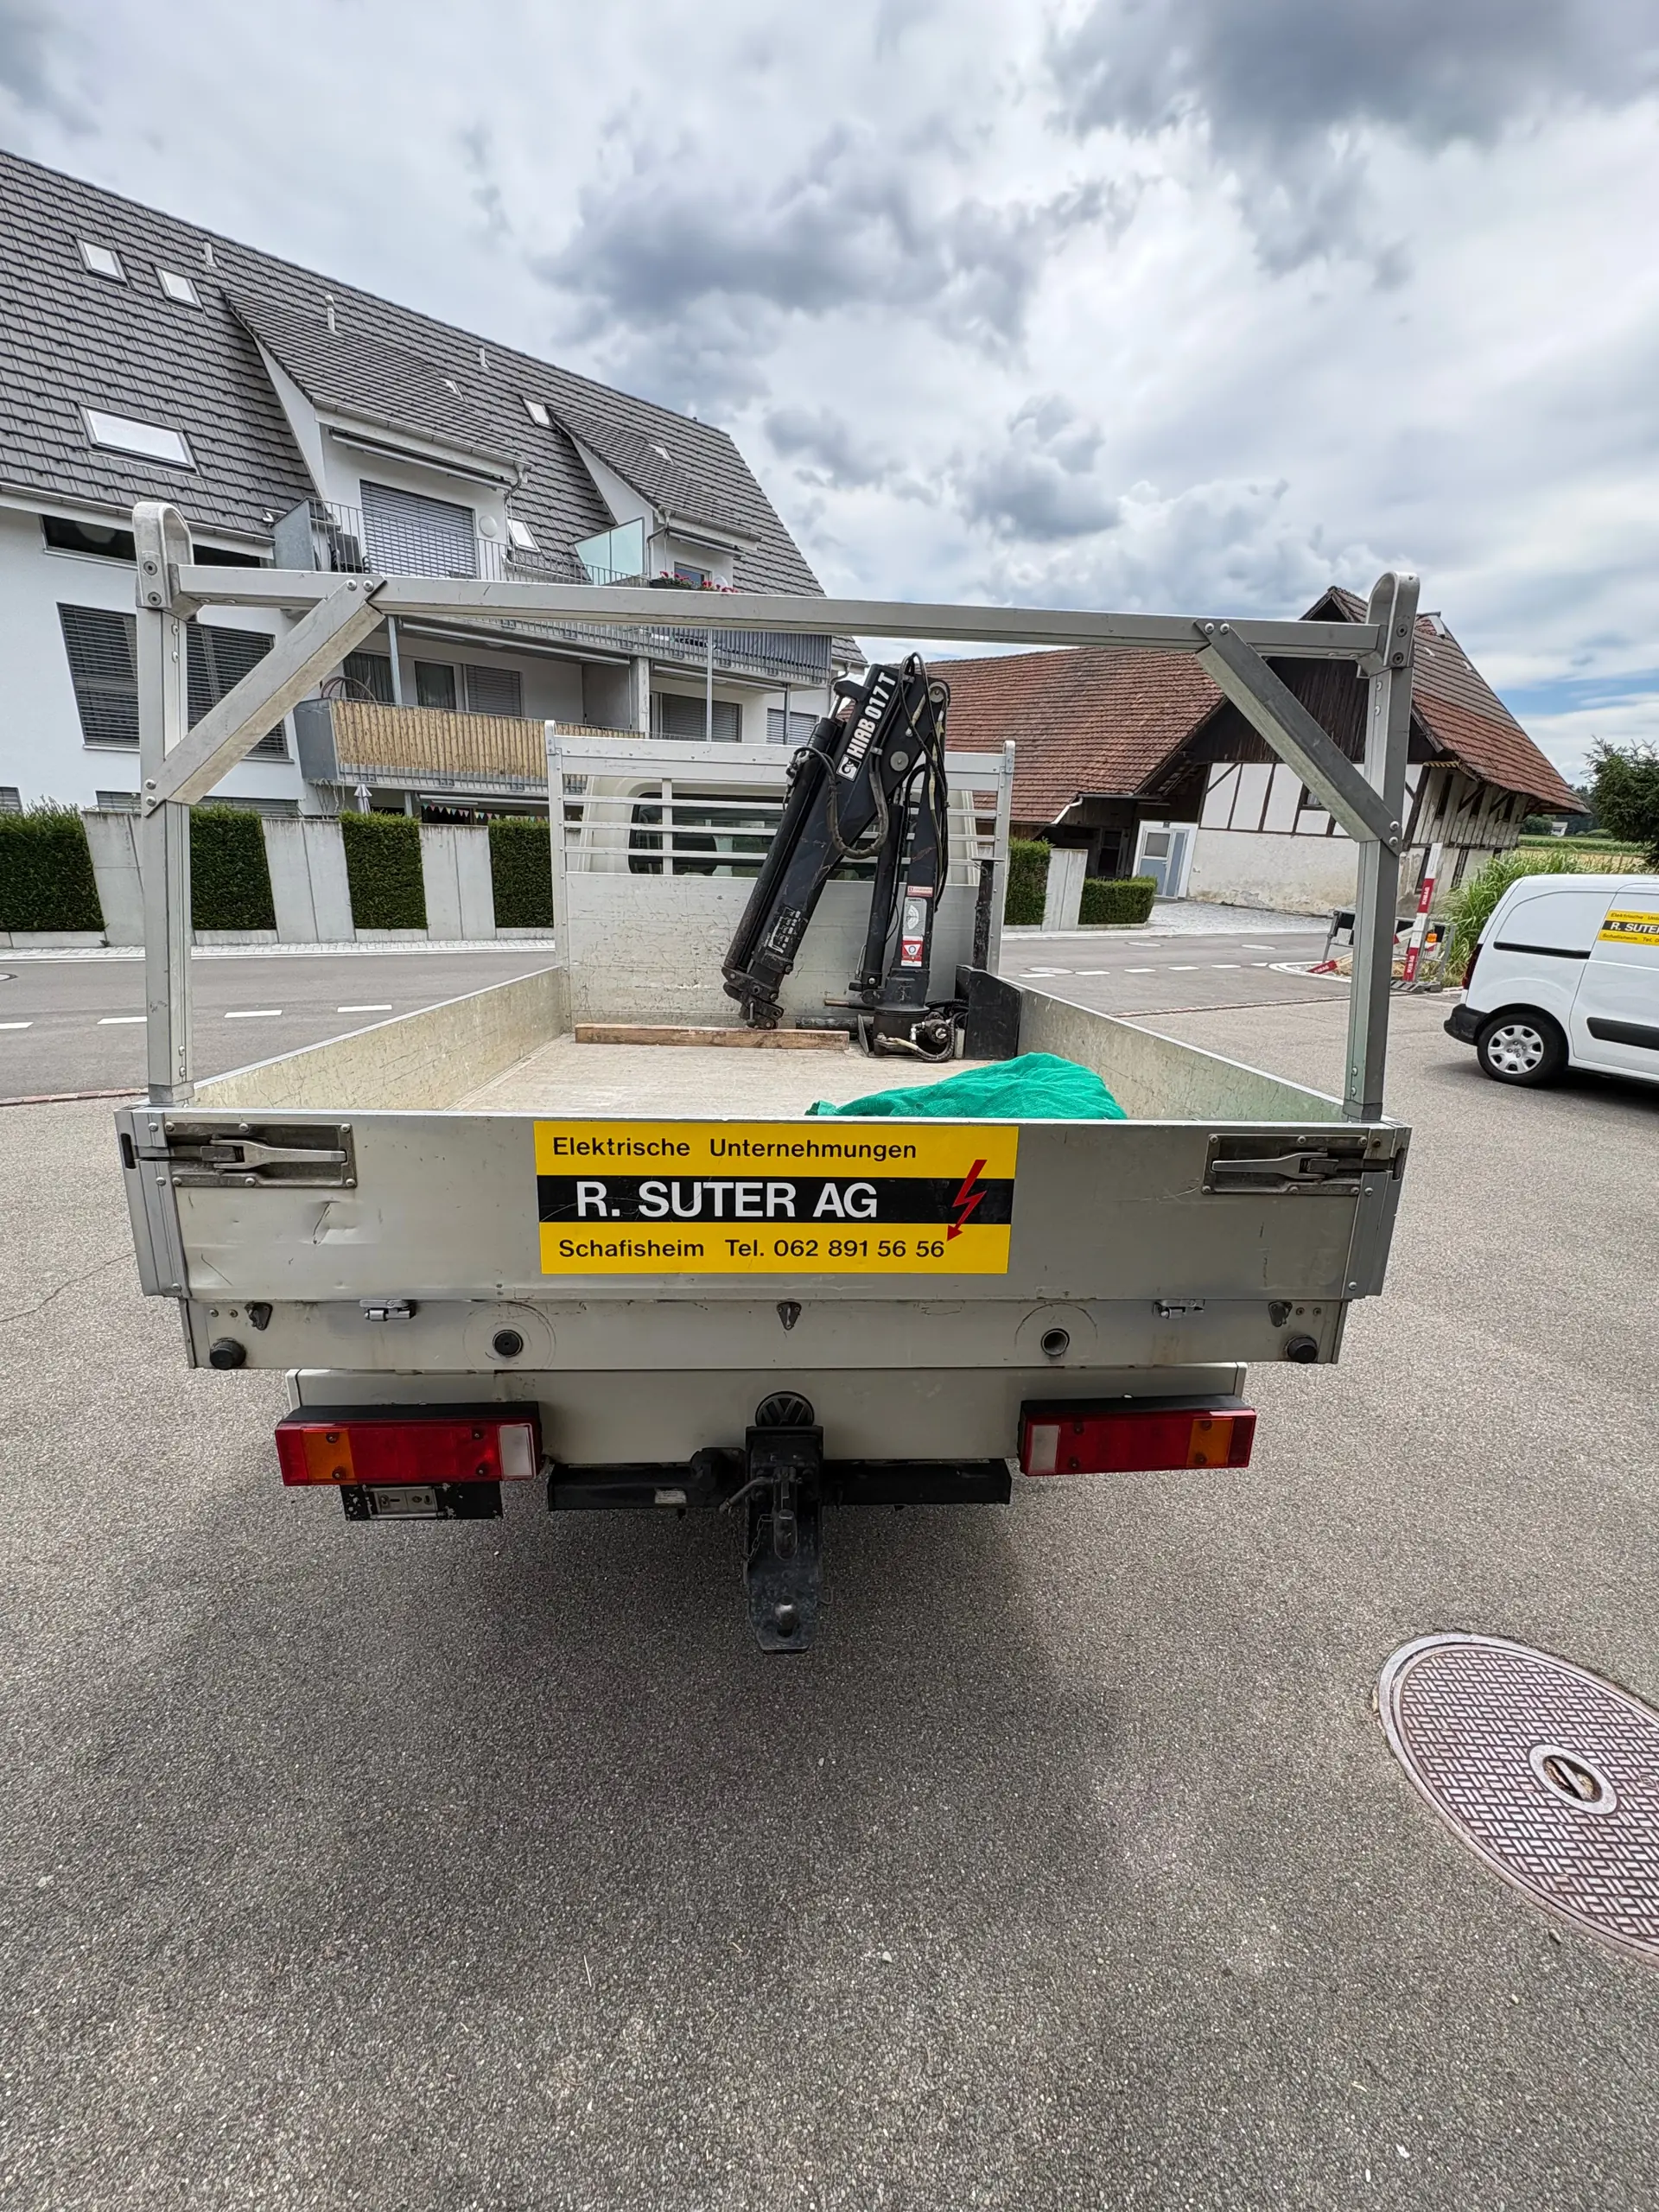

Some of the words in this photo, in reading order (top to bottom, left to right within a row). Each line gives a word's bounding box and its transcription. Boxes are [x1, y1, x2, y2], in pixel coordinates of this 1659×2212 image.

[847, 718, 875, 759] HIAB
[864, 685, 889, 720] 017
[877, 671, 896, 686] T
[1611, 922, 1622, 931] R.
[553, 1137, 690, 1157] Elektrische
[709, 1138, 917, 1162] Unternehmungen
[576, 1181, 620, 1217] R.
[639, 1181, 796, 1217] SUTER
[812, 1182, 878, 1218] AG
[559, 1239, 704, 1257] Schafisheim
[725, 1239, 765, 1257] Tel.
[773, 1239, 818, 1257] 062
[828, 1240, 868, 1257] 891
[877, 1240, 906, 1258] 56
[915, 1240, 944, 1258] 56
